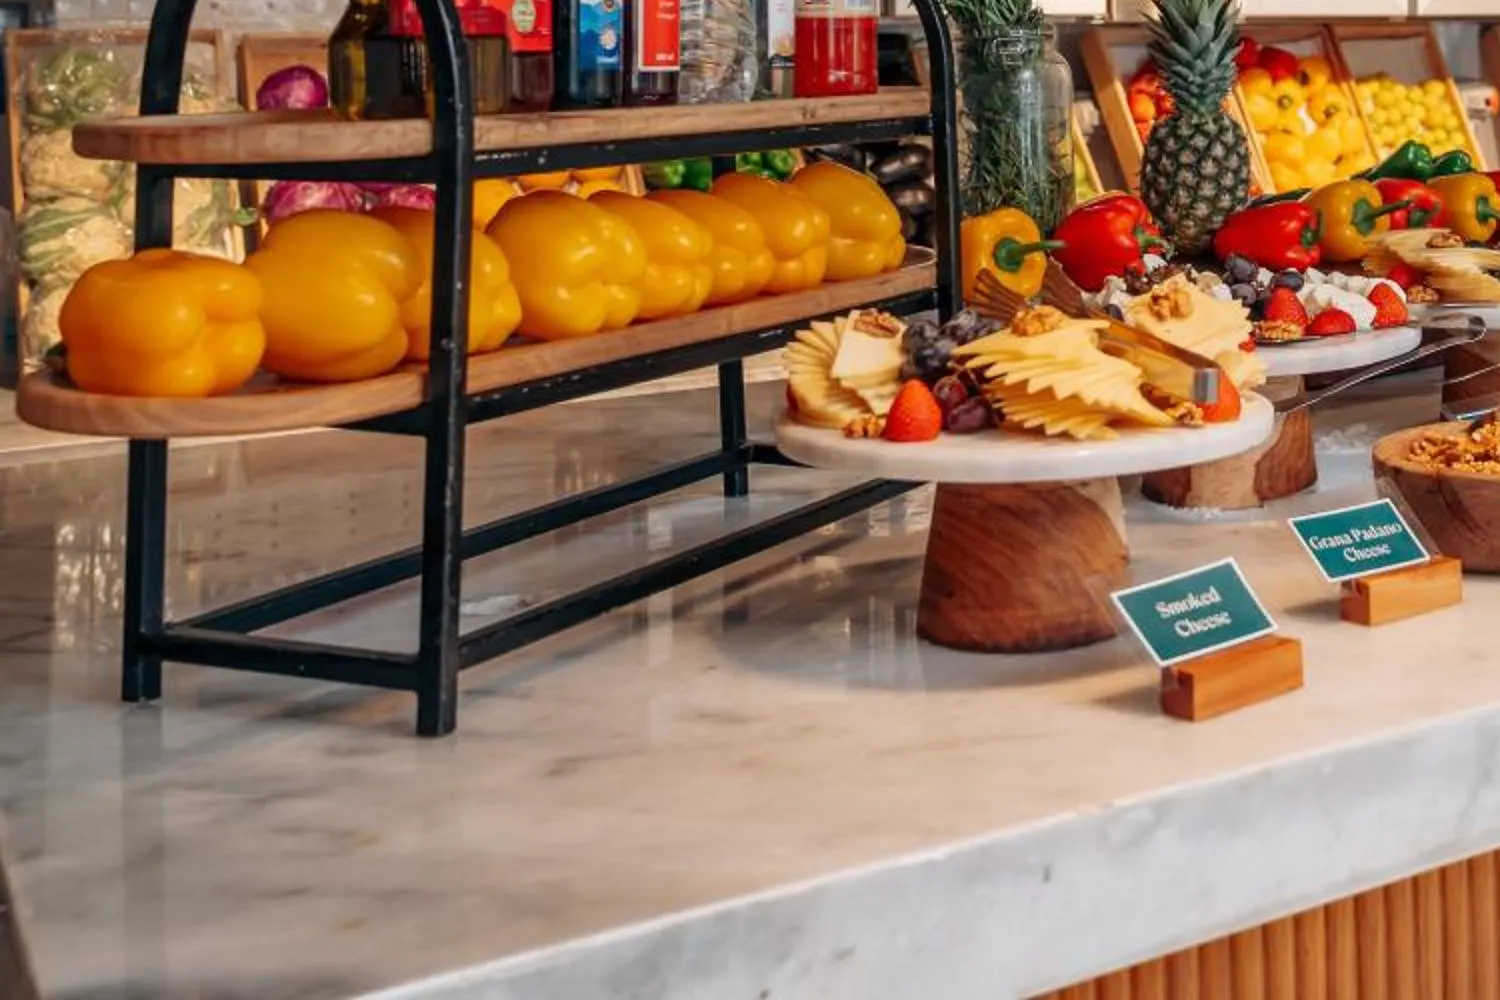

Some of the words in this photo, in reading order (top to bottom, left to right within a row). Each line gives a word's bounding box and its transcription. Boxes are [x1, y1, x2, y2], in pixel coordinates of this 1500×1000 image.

[1309, 533, 1353, 551] Grana
[1350, 521, 1403, 543] Padano
[1343, 543, 1392, 563] Cheese
[1154, 584, 1223, 619] Smoked
[1173, 610, 1233, 637] Cheese
